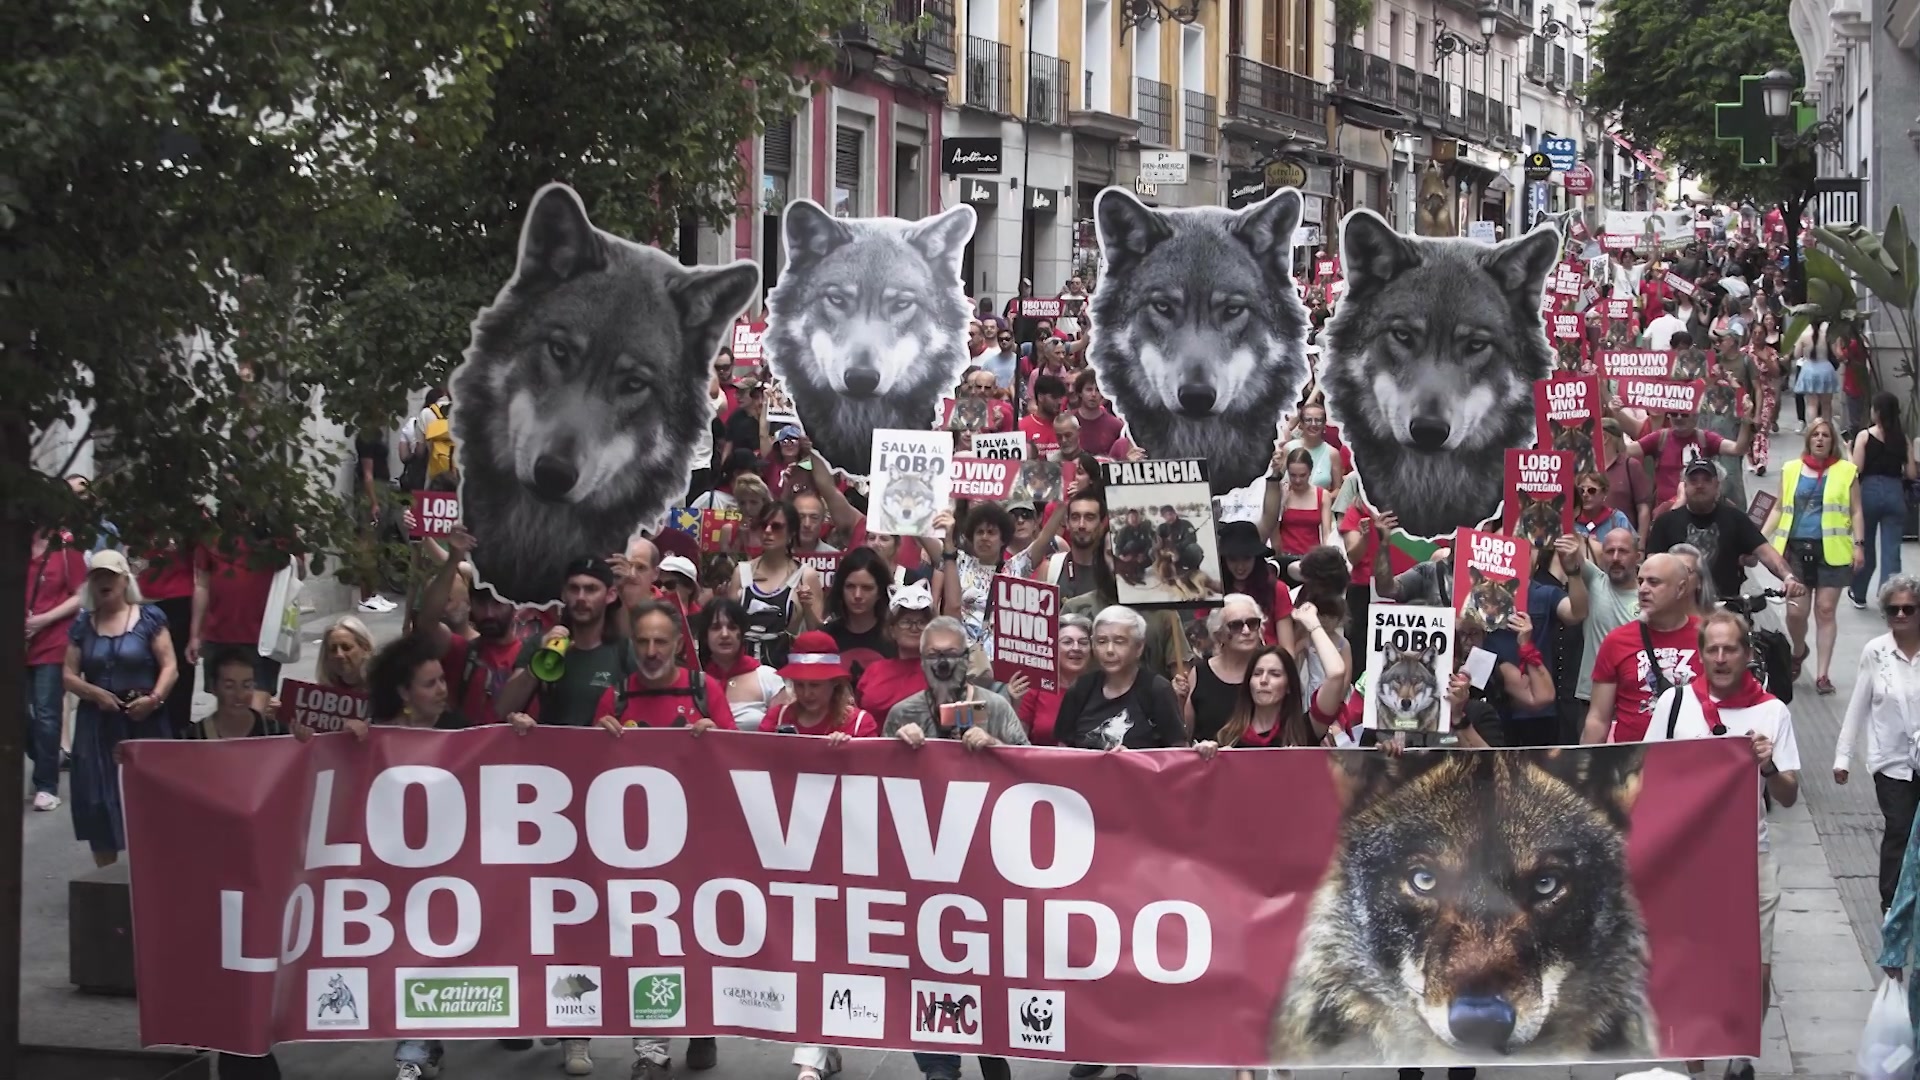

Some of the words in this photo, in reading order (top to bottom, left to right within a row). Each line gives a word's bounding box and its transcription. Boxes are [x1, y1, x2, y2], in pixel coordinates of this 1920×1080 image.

[1553, 315, 1578, 324] LOBO
[1604, 353, 1639, 366] LOBO
[1640, 353, 1668, 366] VIVO
[1605, 366, 1612, 376] Y
[1613, 365, 1667, 376] PROTEGIDO
[1545, 381, 1587, 399] LOBO
[1627, 381, 1664, 397] LOBO
[1664, 384, 1695, 399] VIVO
[1549, 399, 1577, 412] VIVO
[1577, 398, 1584, 409] Y
[1628, 395, 1634, 405] Y
[1634, 396, 1694, 411] PROTEGIDO
[1546, 409, 1590, 421] PROTEGIDO
[881, 441, 926, 455] SALVA
[931, 445, 944, 454] AL
[976, 438, 1008, 449] SALVA
[1011, 438, 1020, 446] AL
[976, 447, 1022, 461] LOBO
[1518, 454, 1562, 471] LOBO
[879, 453, 945, 476] LOBO
[964, 462, 1006, 481] VIVO
[1109, 460, 1202, 485] PALENCIA
[1521, 470, 1549, 483] VIVO
[1550, 473, 1558, 484] Y
[1516, 483, 1562, 493] PROTEGIDO
[423, 518, 432, 532] Y
[1471, 533, 1516, 556] LOBO
[1473, 549, 1502, 566] VIVO
[1504, 557, 1512, 567] Y
[1467, 559, 1516, 577] PROTEGIDO
[1375, 613, 1427, 628] SALVA
[1431, 617, 1446, 628] AL
[998, 637, 1054, 658] NATURALEZA
[1374, 628, 1447, 655] LOBO
[998, 650, 1054, 671] PROTEGIDA
[296, 687, 354, 716] LOBO
[304, 765, 688, 870] LOBO
[729, 769, 1096, 889] VIVO
[220, 876, 482, 972] LOBO
[529, 876, 1213, 984] PROTEGIDO
[440, 981, 504, 1001] anima
[440, 998, 504, 1014] naturalis
[555, 1004, 596, 1017] DIRUS
[916, 990, 979, 1035] NAC
[1021, 1032, 1053, 1045] WWF
